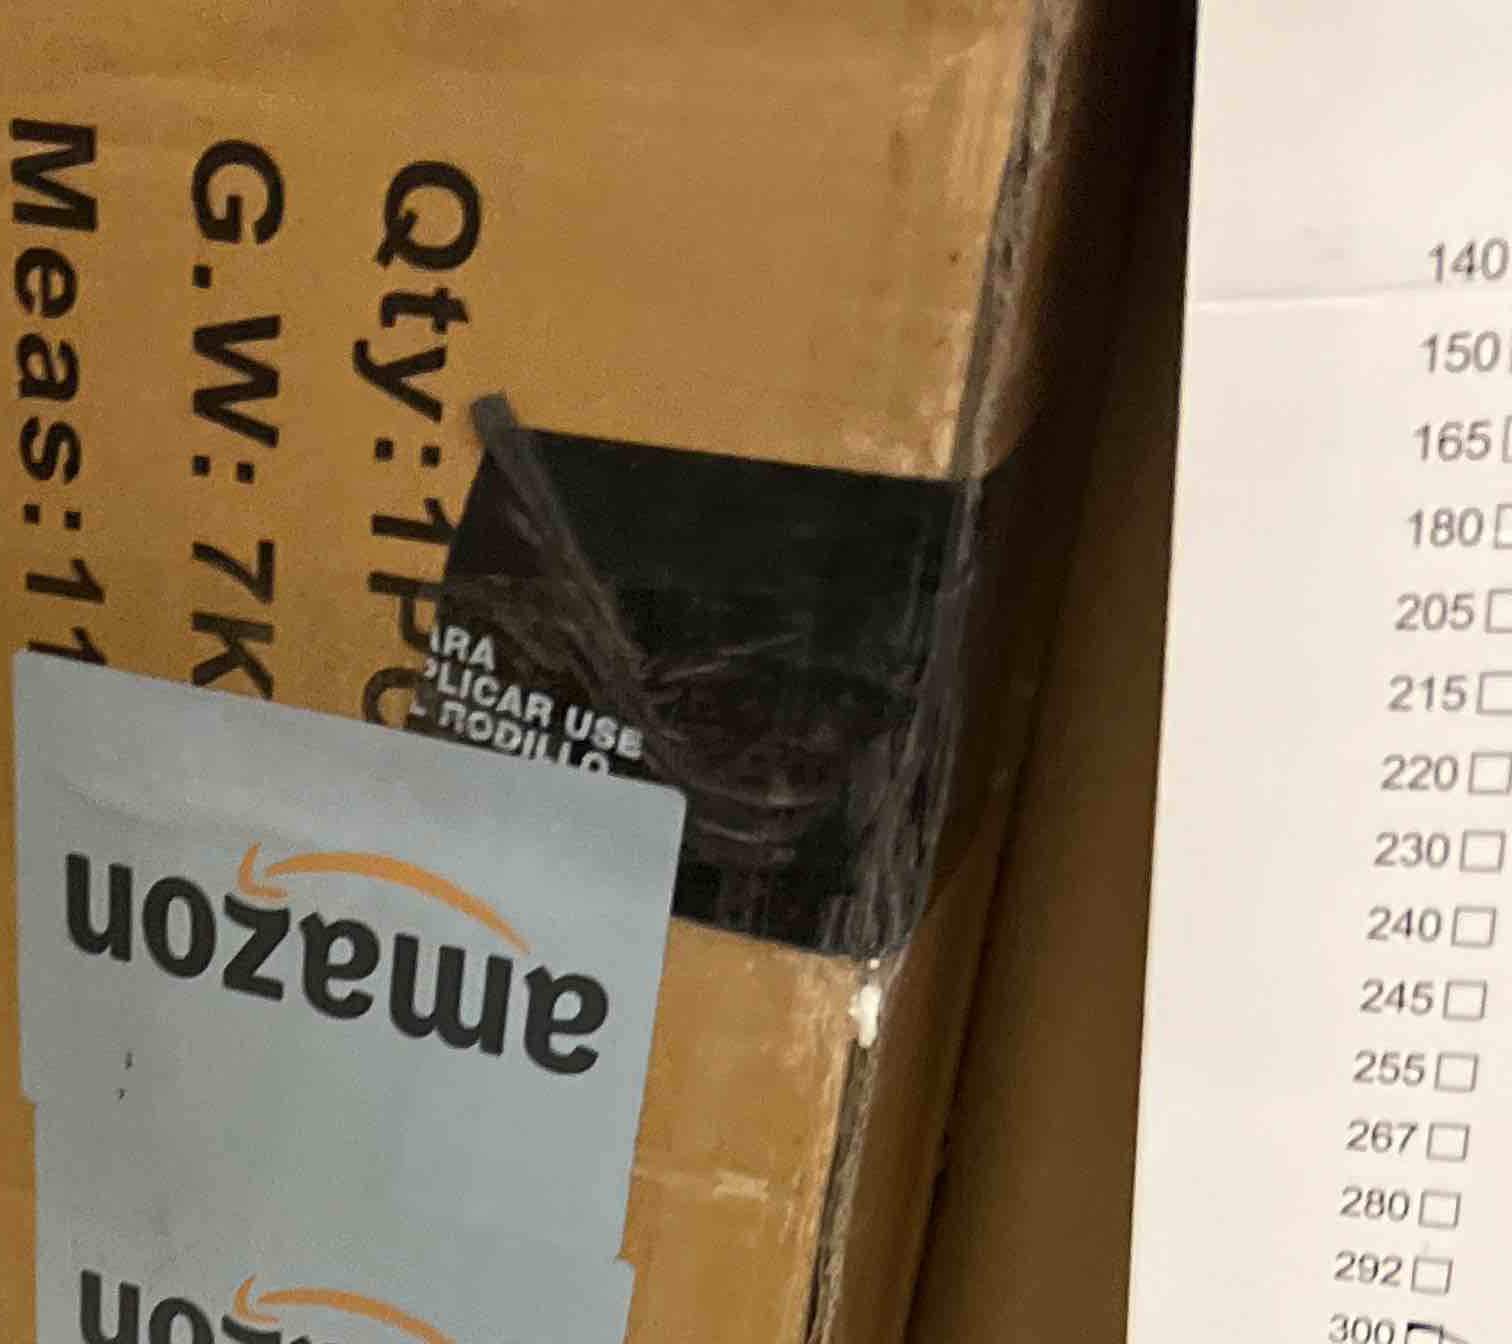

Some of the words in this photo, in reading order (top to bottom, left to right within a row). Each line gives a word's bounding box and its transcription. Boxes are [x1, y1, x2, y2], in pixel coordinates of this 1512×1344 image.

[1427, 239, 1508, 284] 140
[187, 139, 285, 486] G.W:
[1422, 332, 1501, 374] 150
[1414, 422, 1491, 463] 165
[1407, 508, 1483, 549] 180
[1395, 594, 1474, 631] 205
[1388, 675, 1467, 713] 215
[1380, 755, 1458, 791] 220
[1374, 832, 1451, 869] 230
[1366, 907, 1442, 944] 240
[65, 851, 611, 1076] amazon
[1361, 981, 1434, 1017] 245
[1353, 1050, 1426, 1086] 255
[1346, 1120, 1417, 1156] 267
[1340, 1186, 1409, 1223] 280
[1334, 1251, 1403, 1287] 292
